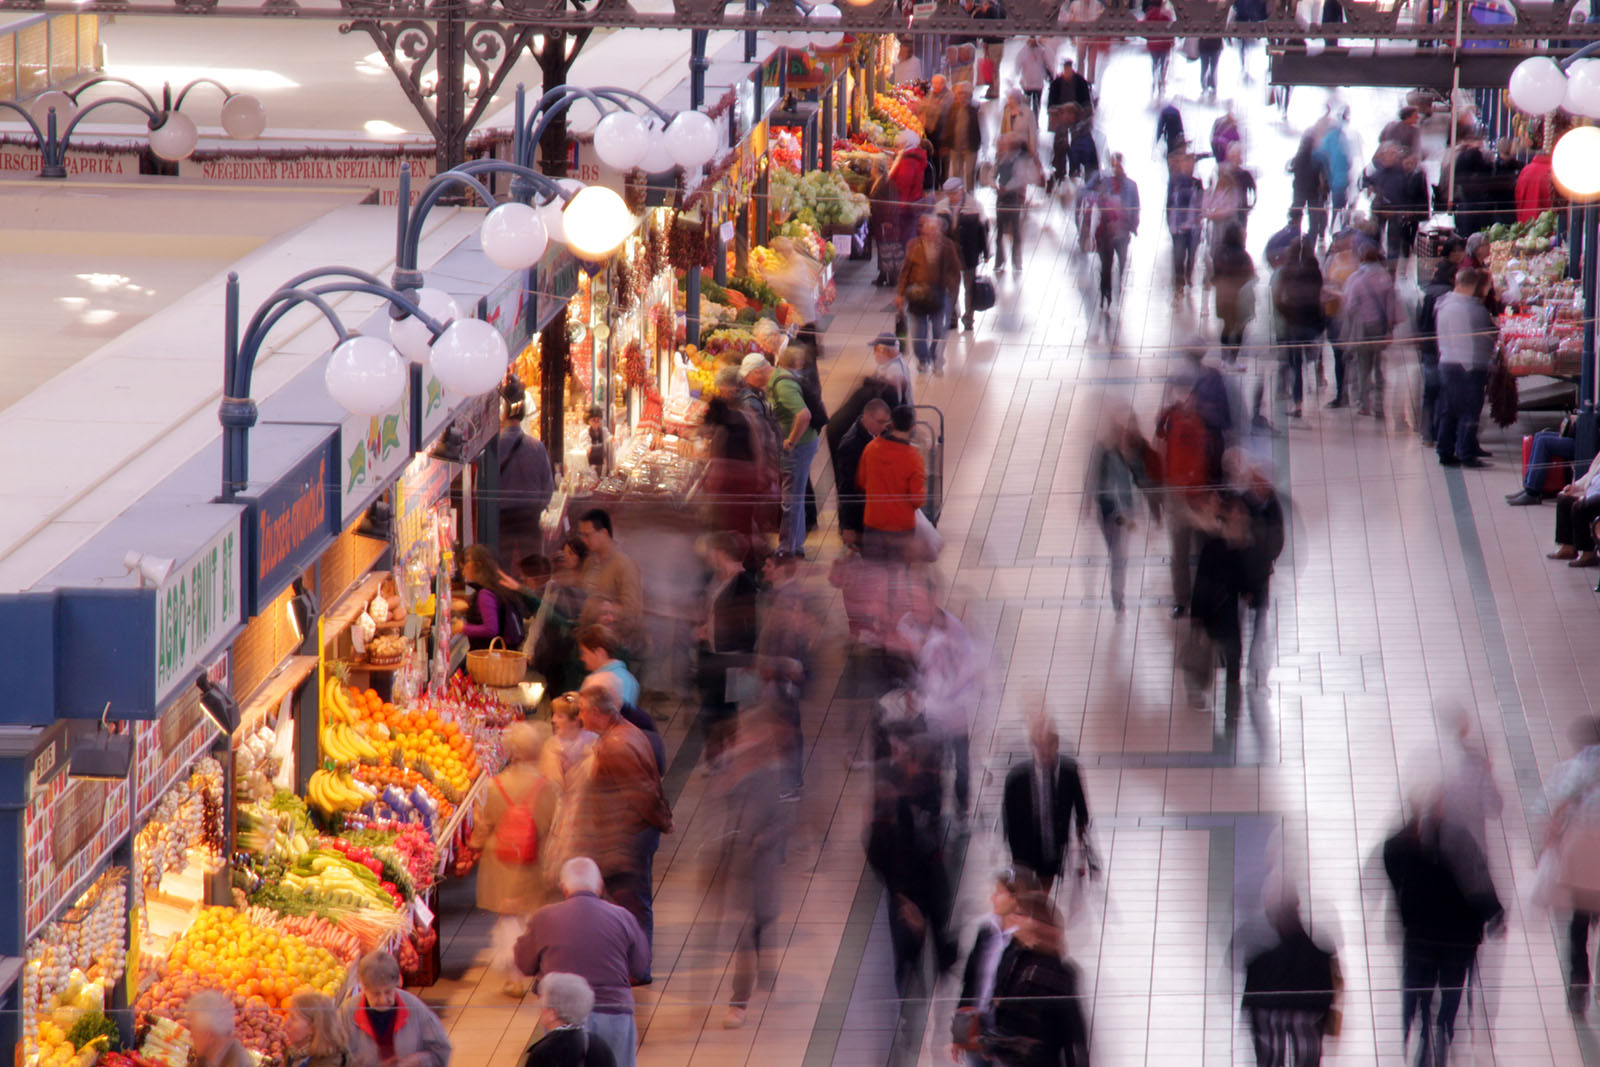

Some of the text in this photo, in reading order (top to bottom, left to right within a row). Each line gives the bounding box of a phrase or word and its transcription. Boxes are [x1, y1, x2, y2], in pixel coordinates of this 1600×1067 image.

[64, 157, 123, 175] PAPRIKA
[202, 160, 427, 180] SZEGEDINER PAPRIKA SPEZIALITEN
[158, 547, 218, 688] AGRO-FRUIT
